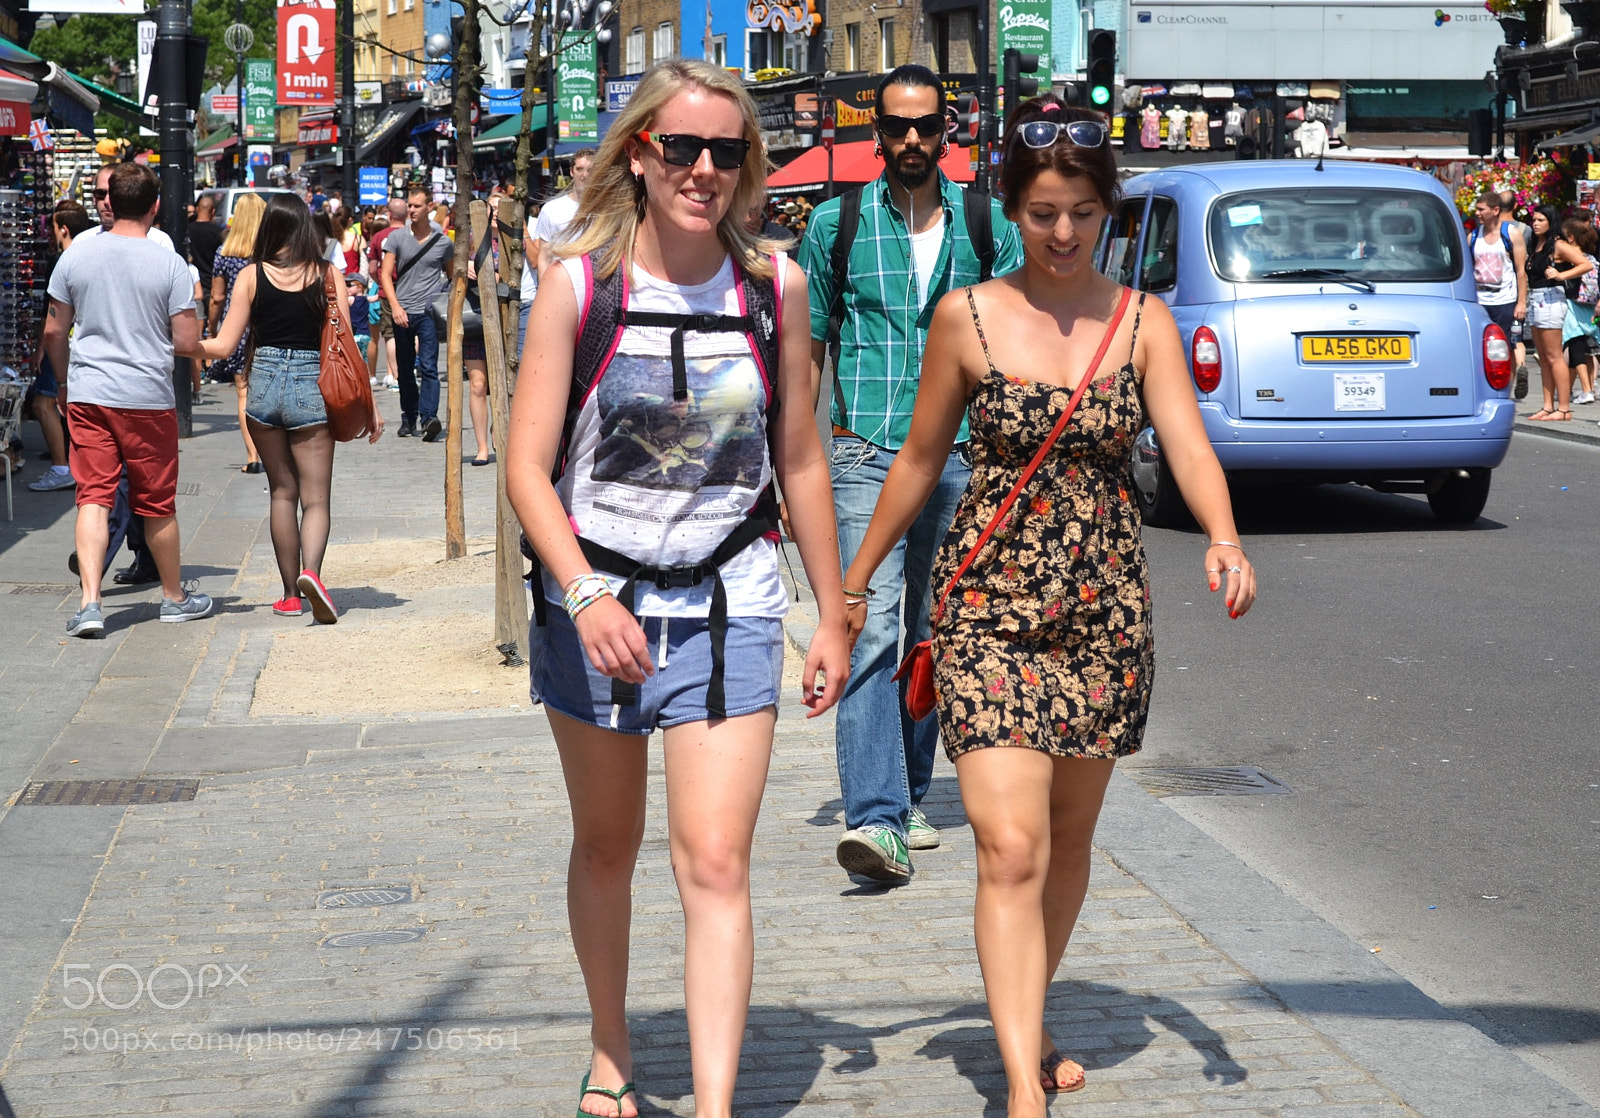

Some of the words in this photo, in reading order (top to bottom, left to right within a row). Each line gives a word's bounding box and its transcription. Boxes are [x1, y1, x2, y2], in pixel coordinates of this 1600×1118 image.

[1000, 5, 1050, 31] Poppies
[1004, 33, 1044, 41] Restaurant
[1027, 42, 1044, 50] Away
[248, 68, 272, 77] FISH
[283, 72, 291, 87] 1
[293, 72, 328, 87] min
[1557, 74, 1600, 100] ELEPHAN
[1310, 338, 1359, 355] LA56
[1344, 386, 1376, 396] 59349
